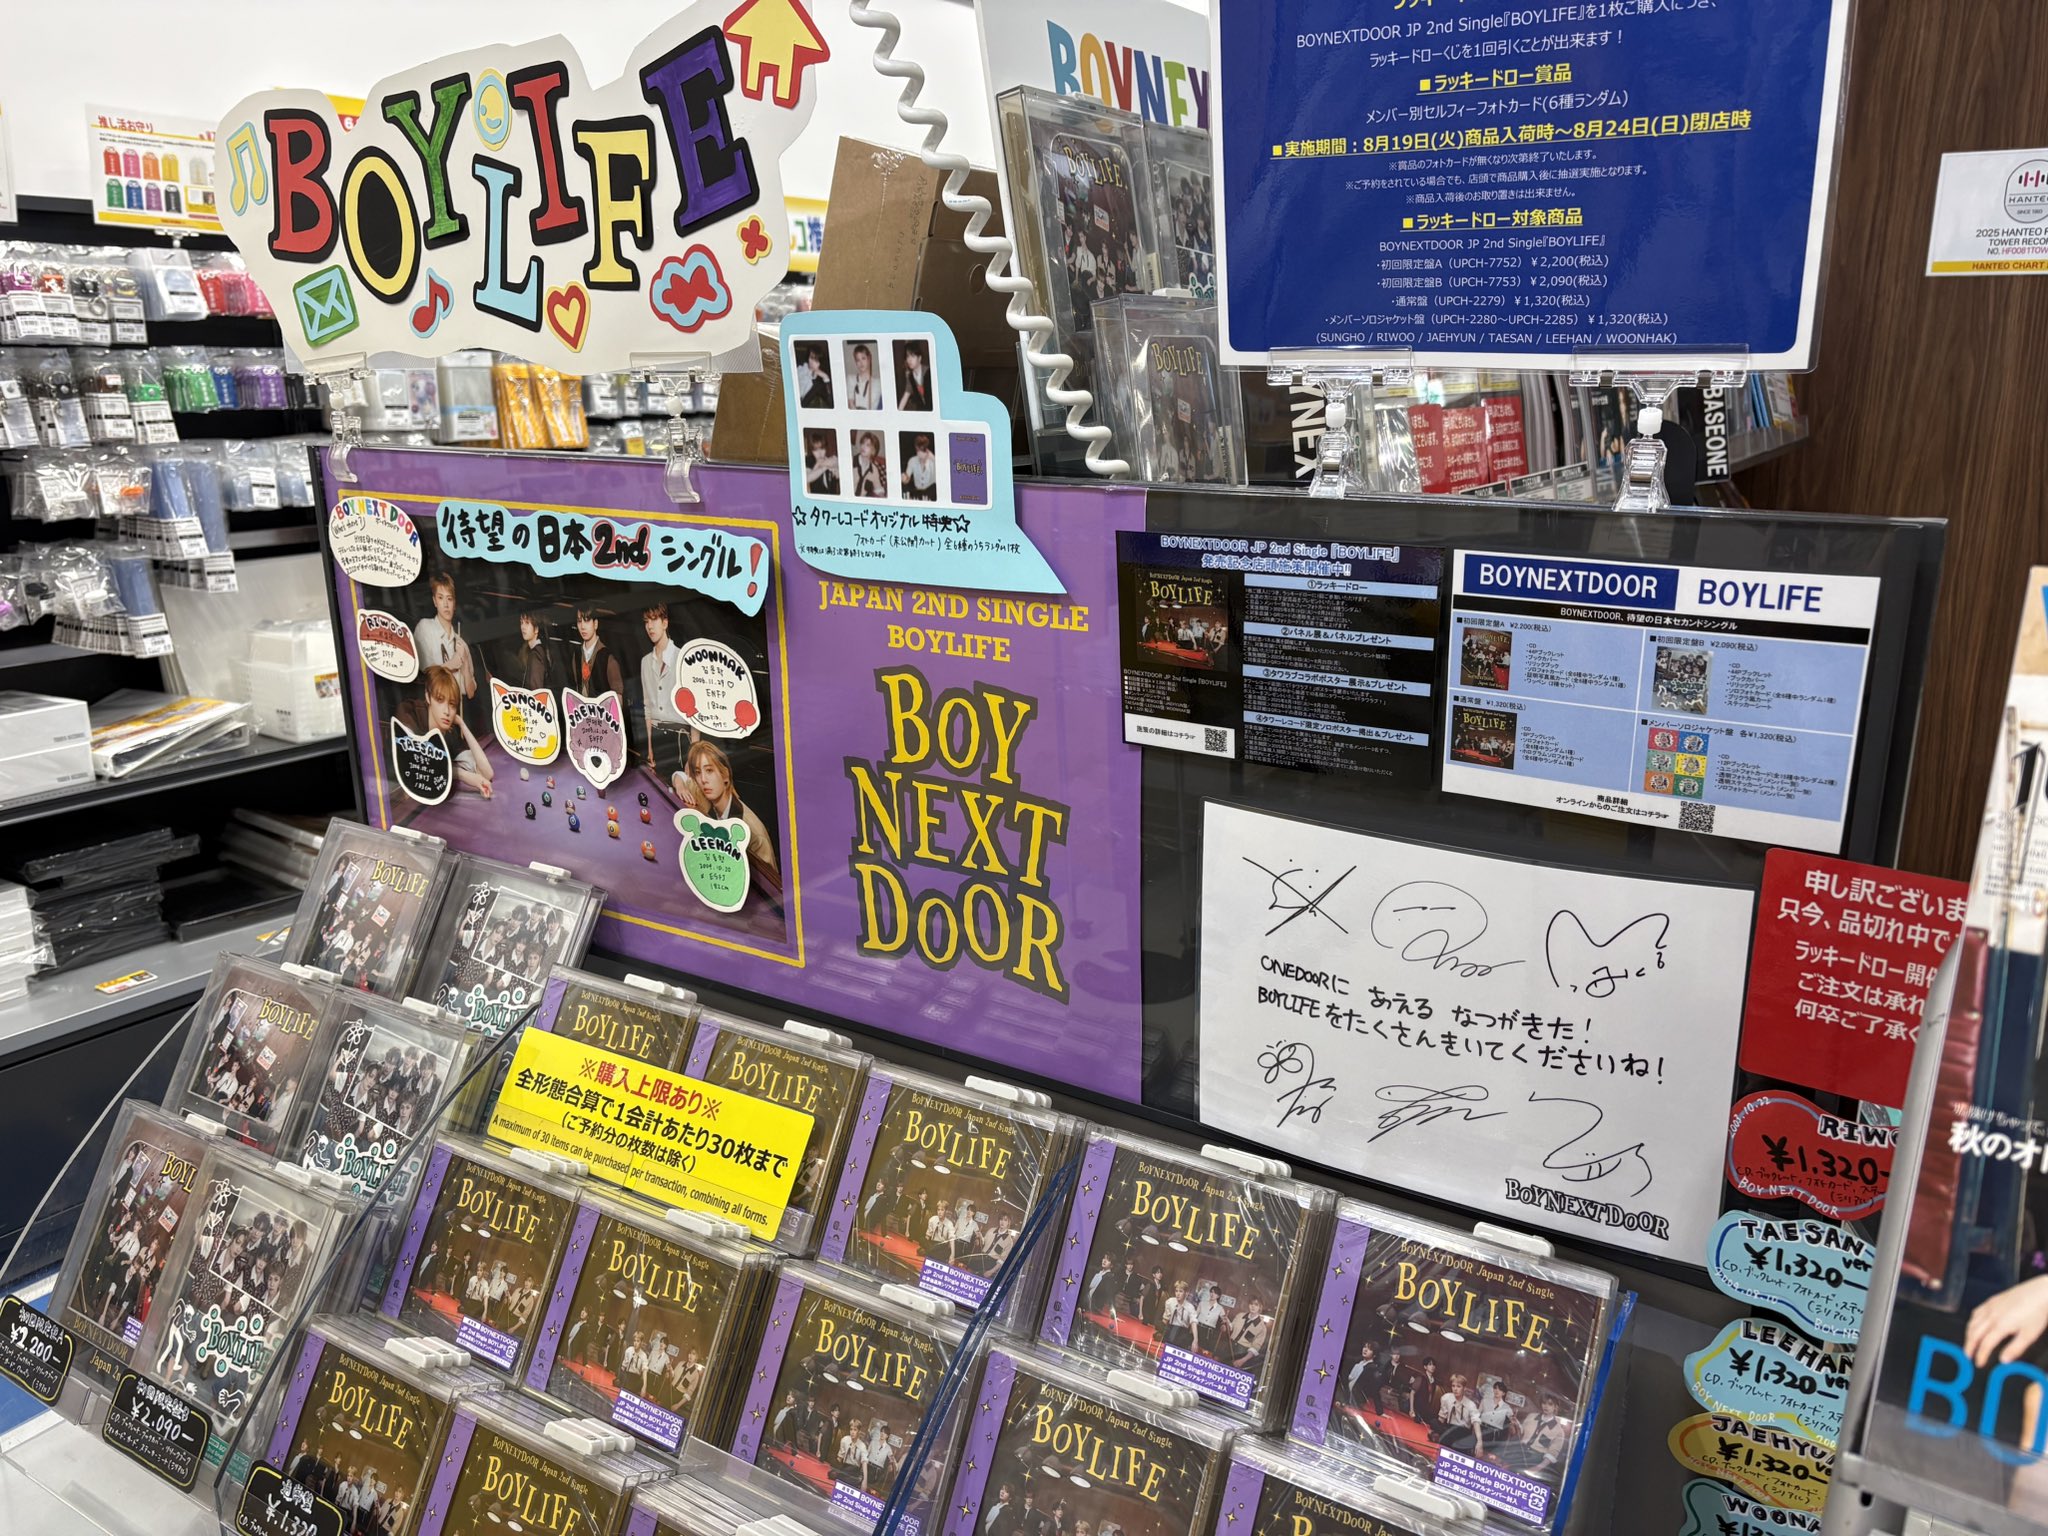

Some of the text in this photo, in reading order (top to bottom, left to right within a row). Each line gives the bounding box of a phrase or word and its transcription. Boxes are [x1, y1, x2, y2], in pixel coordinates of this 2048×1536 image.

[1296, 24, 1401, 48] BOYNEXTDOOR
[1406, 22, 1422, 37] JP
[1426, 18, 1453, 36] 2nd
[1434, 63, 1571, 91] ラッキードロー賞品
[1063, 143, 1124, 189] BOYLIFE
[1417, 207, 1583, 230] ラッキードロー対象商品
[1976, 227, 2042, 238] 2025 HANTEO
[1379, 239, 1463, 252] BOYNEXTDOOR
[1467, 238, 1480, 250] JP
[1483, 237, 1504, 250] 2nd
[1989, 238, 2020, 247] TOWER
[1972, 261, 2045, 270] HANTEO CHART
[1315, 331, 1677, 346] (SUNGHO RIWOO JAEHYUN TAESAN LEEHAN WOONHAK)
[335, 499, 355, 520] BOY
[358, 498, 388, 518] NEXT
[390, 505, 421, 548] DOOR
[1160, 535, 1249, 552] BOYNEXTDOOR
[1250, 538, 1266, 552] JP
[1270, 540, 1291, 555] 2nd
[1294, 541, 1328, 558] Single
[818, 580, 1090, 633] JAPAN 2ND SINGLE
[1151, 580, 1213, 606] BOYLIFE
[1479, 563, 1824, 612] BOYNEXTDOOR BOYLIFE
[367, 616, 404, 637] RIWOO
[886, 624, 1012, 662] BOYLIFE
[684, 649, 748, 681] WOONHAK
[501, 693, 554, 724] SUNGHO
[569, 704, 620, 733] JAEHYUN
[879, 671, 1033, 786] BOY
[1463, 713, 1507, 730] BOYLIFE
[691, 838, 742, 861] LEEHAN
[850, 765, 1064, 889] NEXT
[371, 859, 430, 898] BOYLIFE
[854, 862, 1064, 993] DOOR
[1777, 896, 1960, 954] 只今、品切れ中で
[259, 996, 319, 1041] BOYLIFE
[1367, 986, 1434, 1019] あえる
[573, 1004, 656, 1060] BOYLIFE
[729, 1050, 825, 1115] BOYLIFE
[904, 1110, 1012, 1180] BOYLIFE
[492, 1114, 769, 1226] A maximum of 30 items can be purchased per transaction, combining all forms.
[456, 1177, 541, 1245] BOYLIFE
[1131, 1178, 1261, 1261] BOYLIFE
[1504, 1177, 1670, 1240] BOYNEXTDOOR
[1737, 1219, 1864, 1257] TAESAN
[607, 1239, 703, 1315] BOYLIFE
[1400, 1238, 1555, 1300] BOYNEXTDOOR Japan 2nd Single
[1394, 1260, 1550, 1354] BOYLIFE
[815, 1318, 927, 1401] BOYLIFE
[327, 1370, 415, 1450] BOYLIFE
[1032, 1404, 1166, 1504] BOYLIFE
[1475, 1461, 1548, 1497] BOYNEXTDOOR
